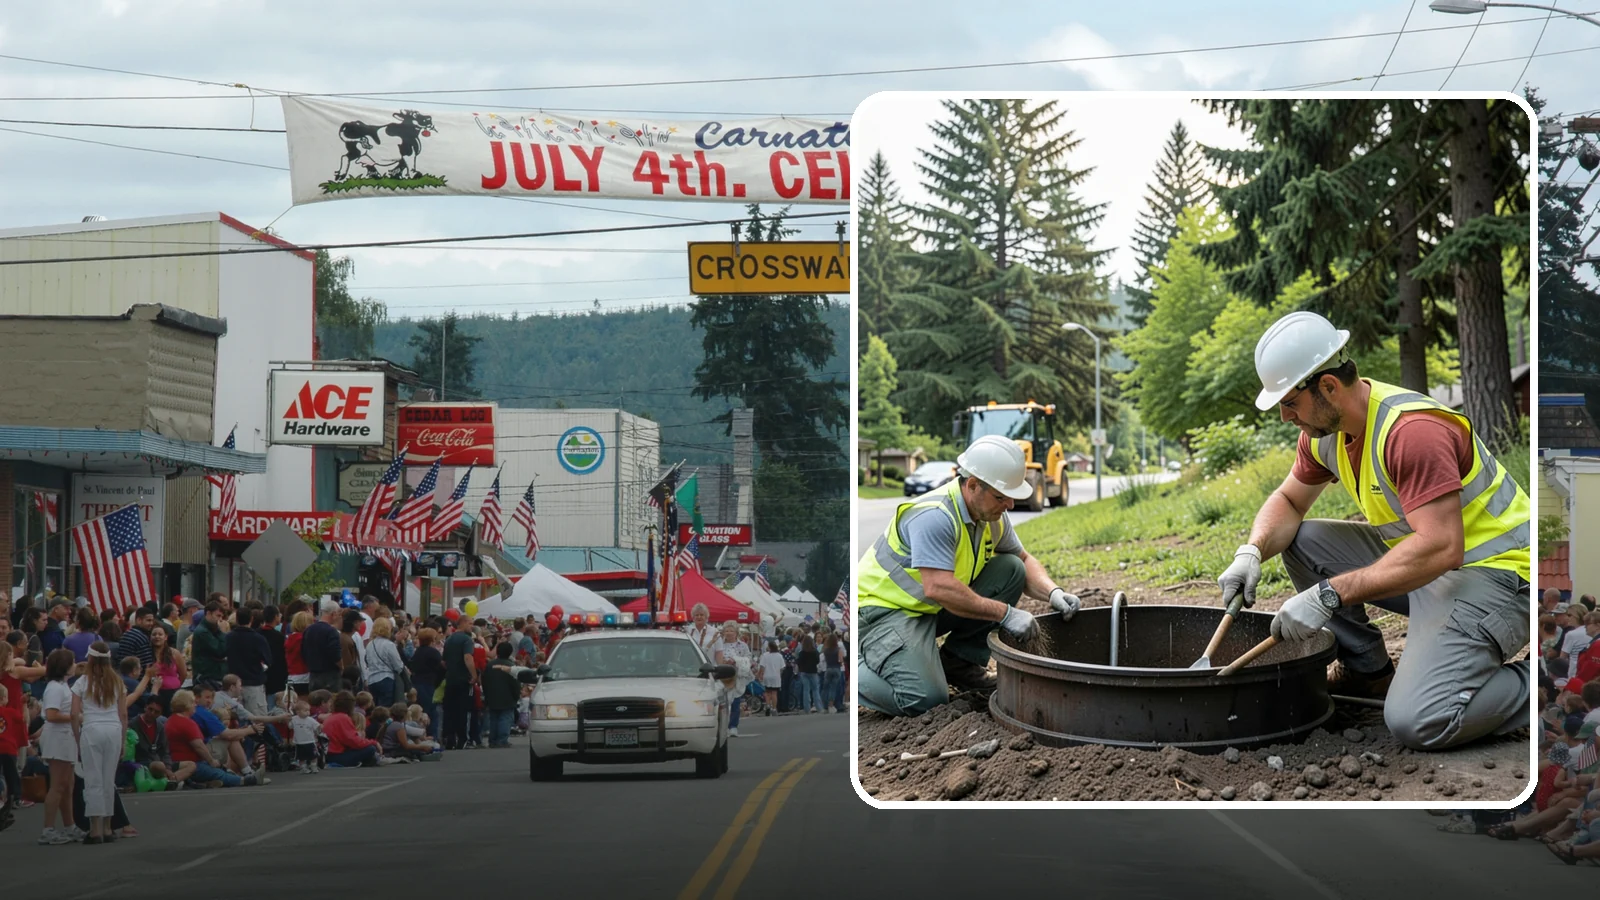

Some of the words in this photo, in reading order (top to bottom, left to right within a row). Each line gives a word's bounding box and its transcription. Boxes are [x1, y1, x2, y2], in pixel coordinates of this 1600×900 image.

[695, 121, 850, 150] Carnat
[481, 141, 605, 192] JULY
[632, 150, 747, 198] 4th.
[697, 254, 850, 280] CROSSWA
[282, 380, 374, 420] ACE
[406, 409, 452, 422] CEDAR
[461, 409, 485, 422] LOG
[283, 421, 370, 436] Hardware
[416, 428, 477, 447] Coca-Cola
[83, 486, 93, 494] St.
[95, 485, 124, 495] Vincent
[126, 486, 135, 494] de
[137, 486, 155, 495] Paul
[213, 516, 330, 535] HARDARE
[688, 526, 741, 535] CRNATION
[699, 535, 731, 543] GLASS
